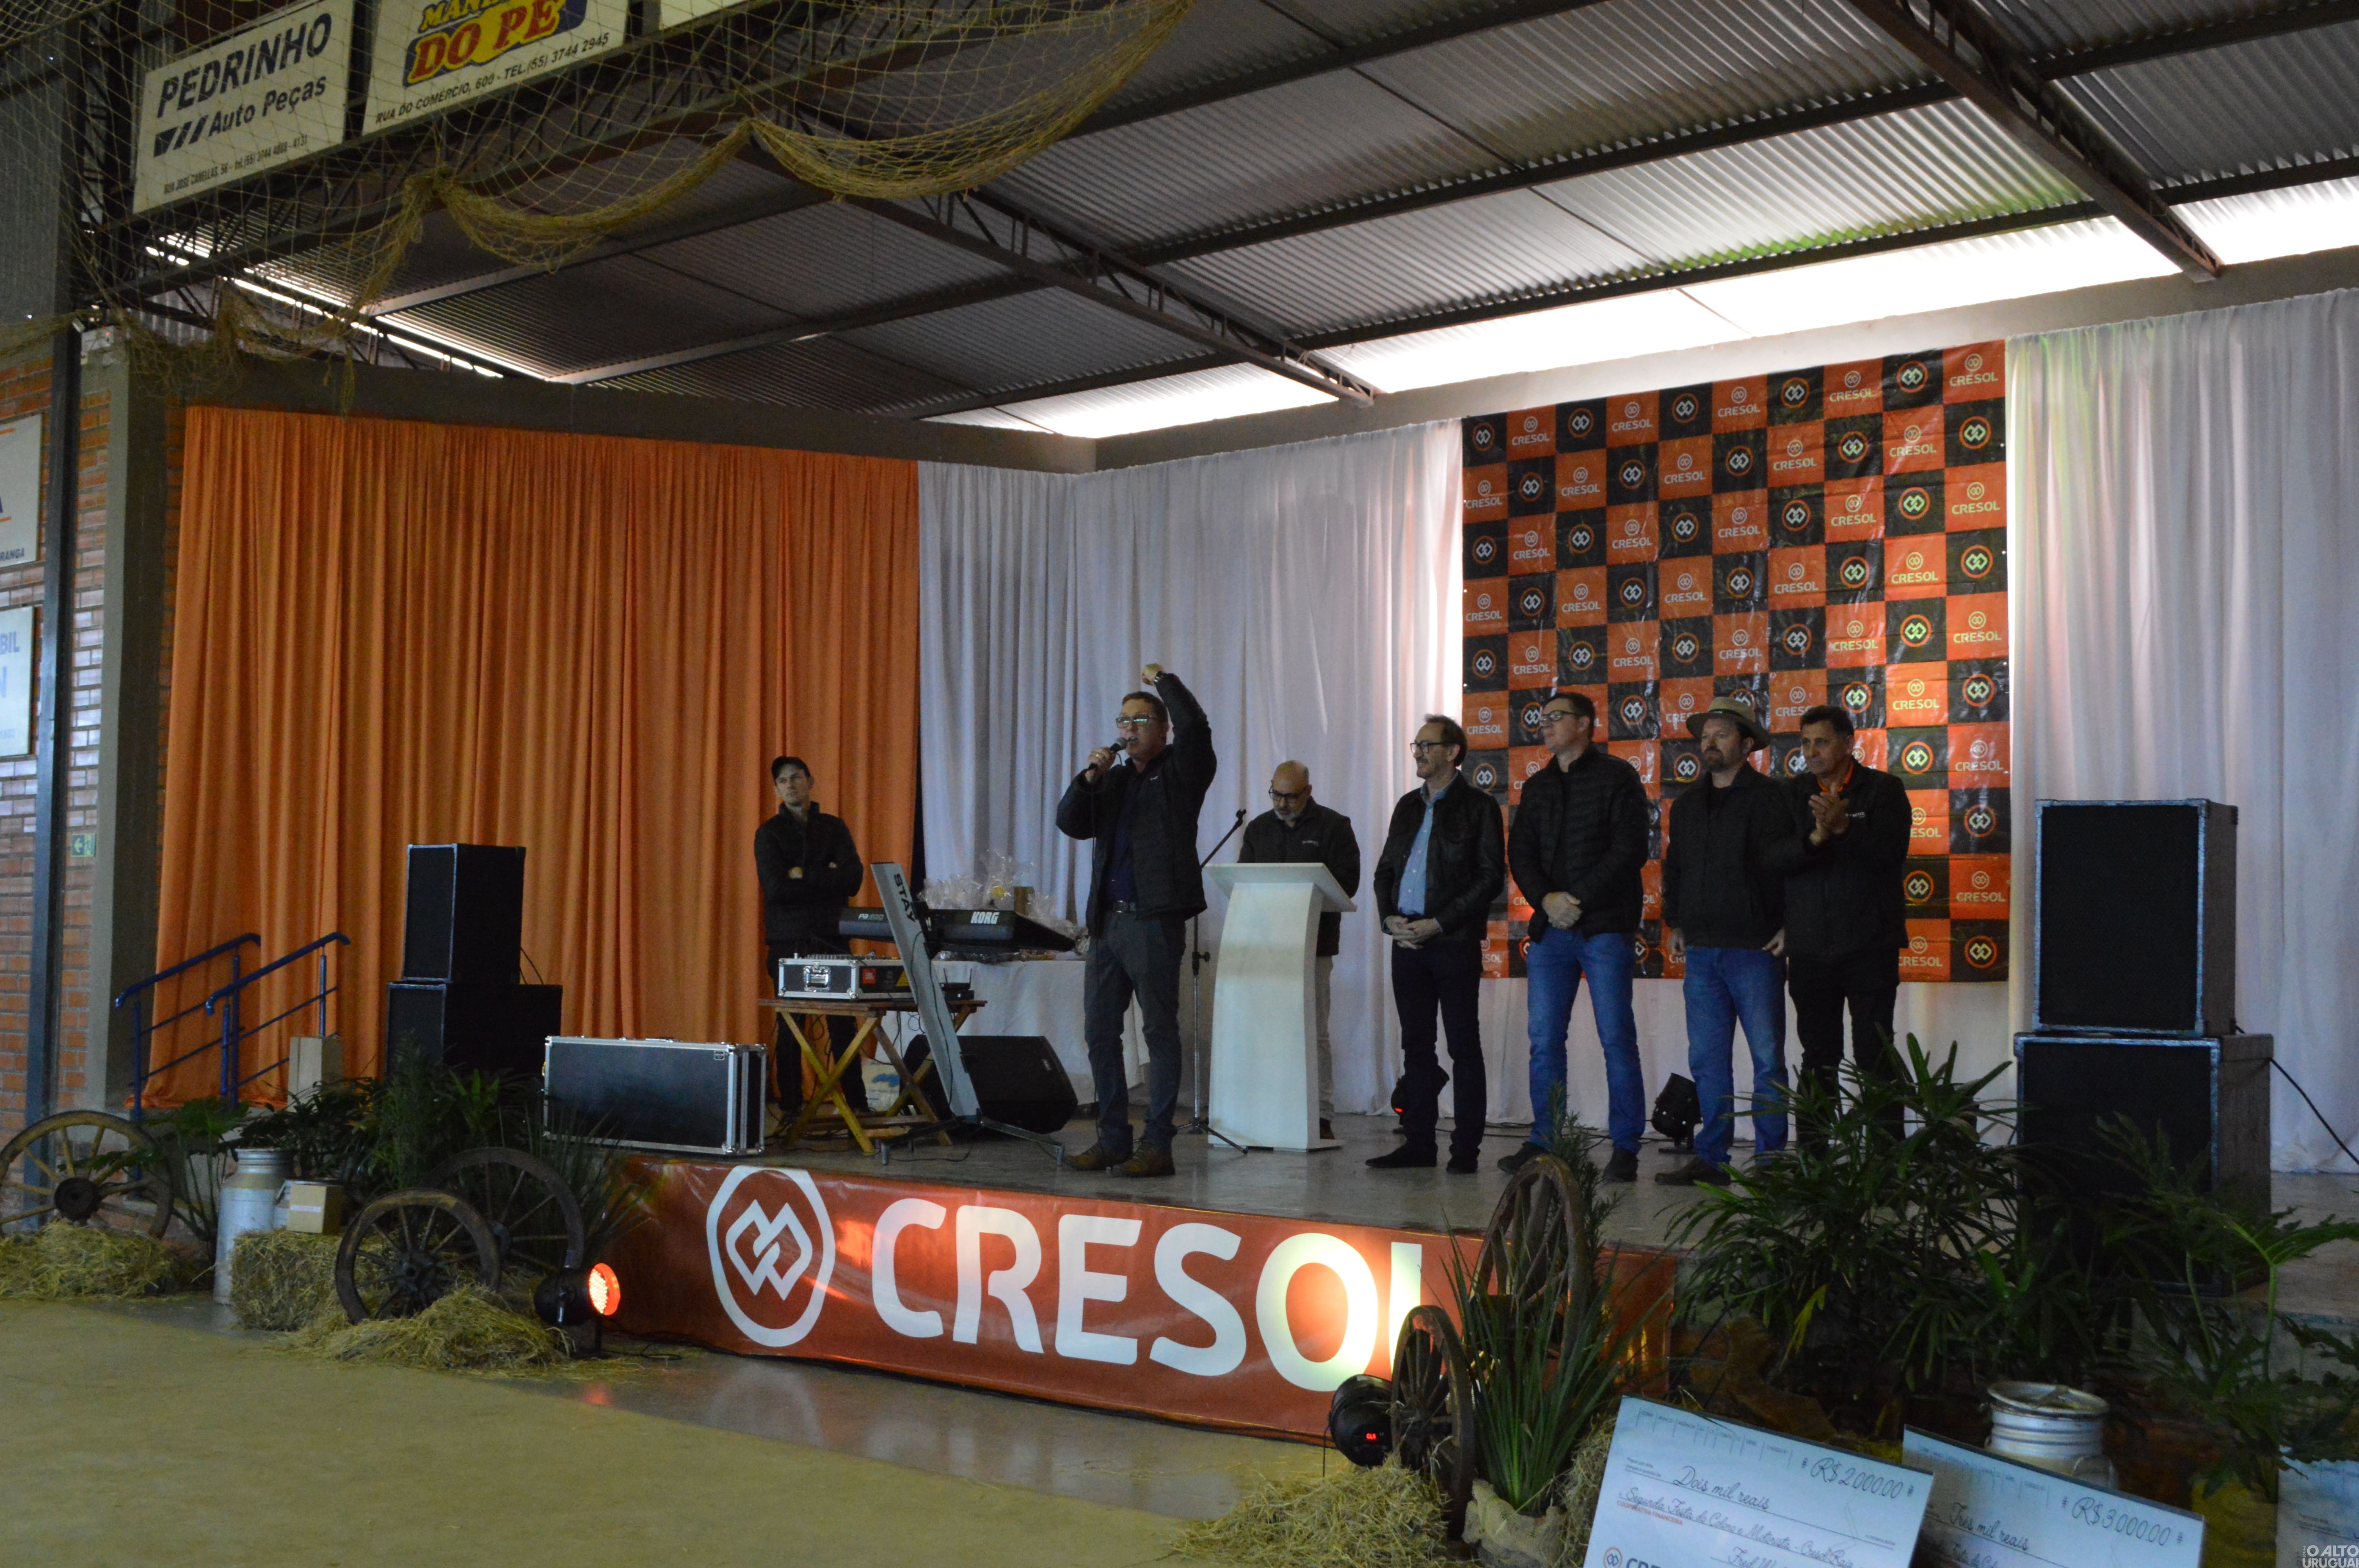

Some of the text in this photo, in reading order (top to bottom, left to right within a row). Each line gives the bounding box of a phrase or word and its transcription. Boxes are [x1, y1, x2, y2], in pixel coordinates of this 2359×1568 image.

[410, 23, 481, 79] DO
[157, 13, 332, 118] PEDRINHO
[375, 108, 395, 124] RUA
[398, 102, 413, 116] DO
[551, 47, 578, 63] 3744
[209, 76, 327, 137] Auto Peças
[1950, 372, 1999, 387] CRESOL
[1829, 388, 1876, 402] CRESOL
[1718, 404, 1760, 418] CRESOL
[1612, 419, 1652, 432] CRESOL
[1512, 433, 1550, 446] CRESOL
[1889, 444, 1937, 457] CRESOL
[1773, 458, 1817, 471] CRESOL
[1664, 471, 1706, 485] CRESOL
[1561, 484, 1600, 497] CRESOL
[1466, 497, 1503, 509] CRESOL
[1952, 501, 2001, 515] CRESOL
[1831, 514, 1877, 527] CRESOL
[1718, 525, 1761, 539] CRESOL
[1612, 537, 1653, 550] CRESOL
[1513, 548, 1550, 561] CRESOL
[1891, 571, 1938, 584] CRESOL
[1774, 581, 1819, 594] CRESOL
[1665, 591, 1706, 604] CRESOL
[1562, 601, 1601, 613] CRESOL
[1466, 610, 1503, 622] CRESOL
[1953, 631, 2002, 644] CRESOL
[1833, 639, 1878, 652] CRESOL
[1719, 647, 1762, 660] CRESOL
[1613, 656, 1653, 667] CRESOL
[1514, 663, 1551, 675] CRESOL
[1776, 706, 1812, 717] CRES
[1893, 699, 1940, 711] CRESOL
[1467, 724, 1503, 735] CRESOL
[1955, 760, 2003, 772] CRESOL
[1910, 828, 1942, 838] ESOL
[894, 873, 917, 922] STAY
[1956, 892, 2006, 902] CRESOL
[970, 911, 1000, 924] KORG
[1673, 1465, 1770, 1510] Dois mil reais
[1626, 1487, 1665, 1511] Segunda
[1667, 1498, 1694, 1520] Festa
[1616, 1500, 1683, 1526] COOPERATIVA FINANCEIRA
[1977, 1520, 1999, 1539] mil
[2001, 1530, 2030, 1551] reais
